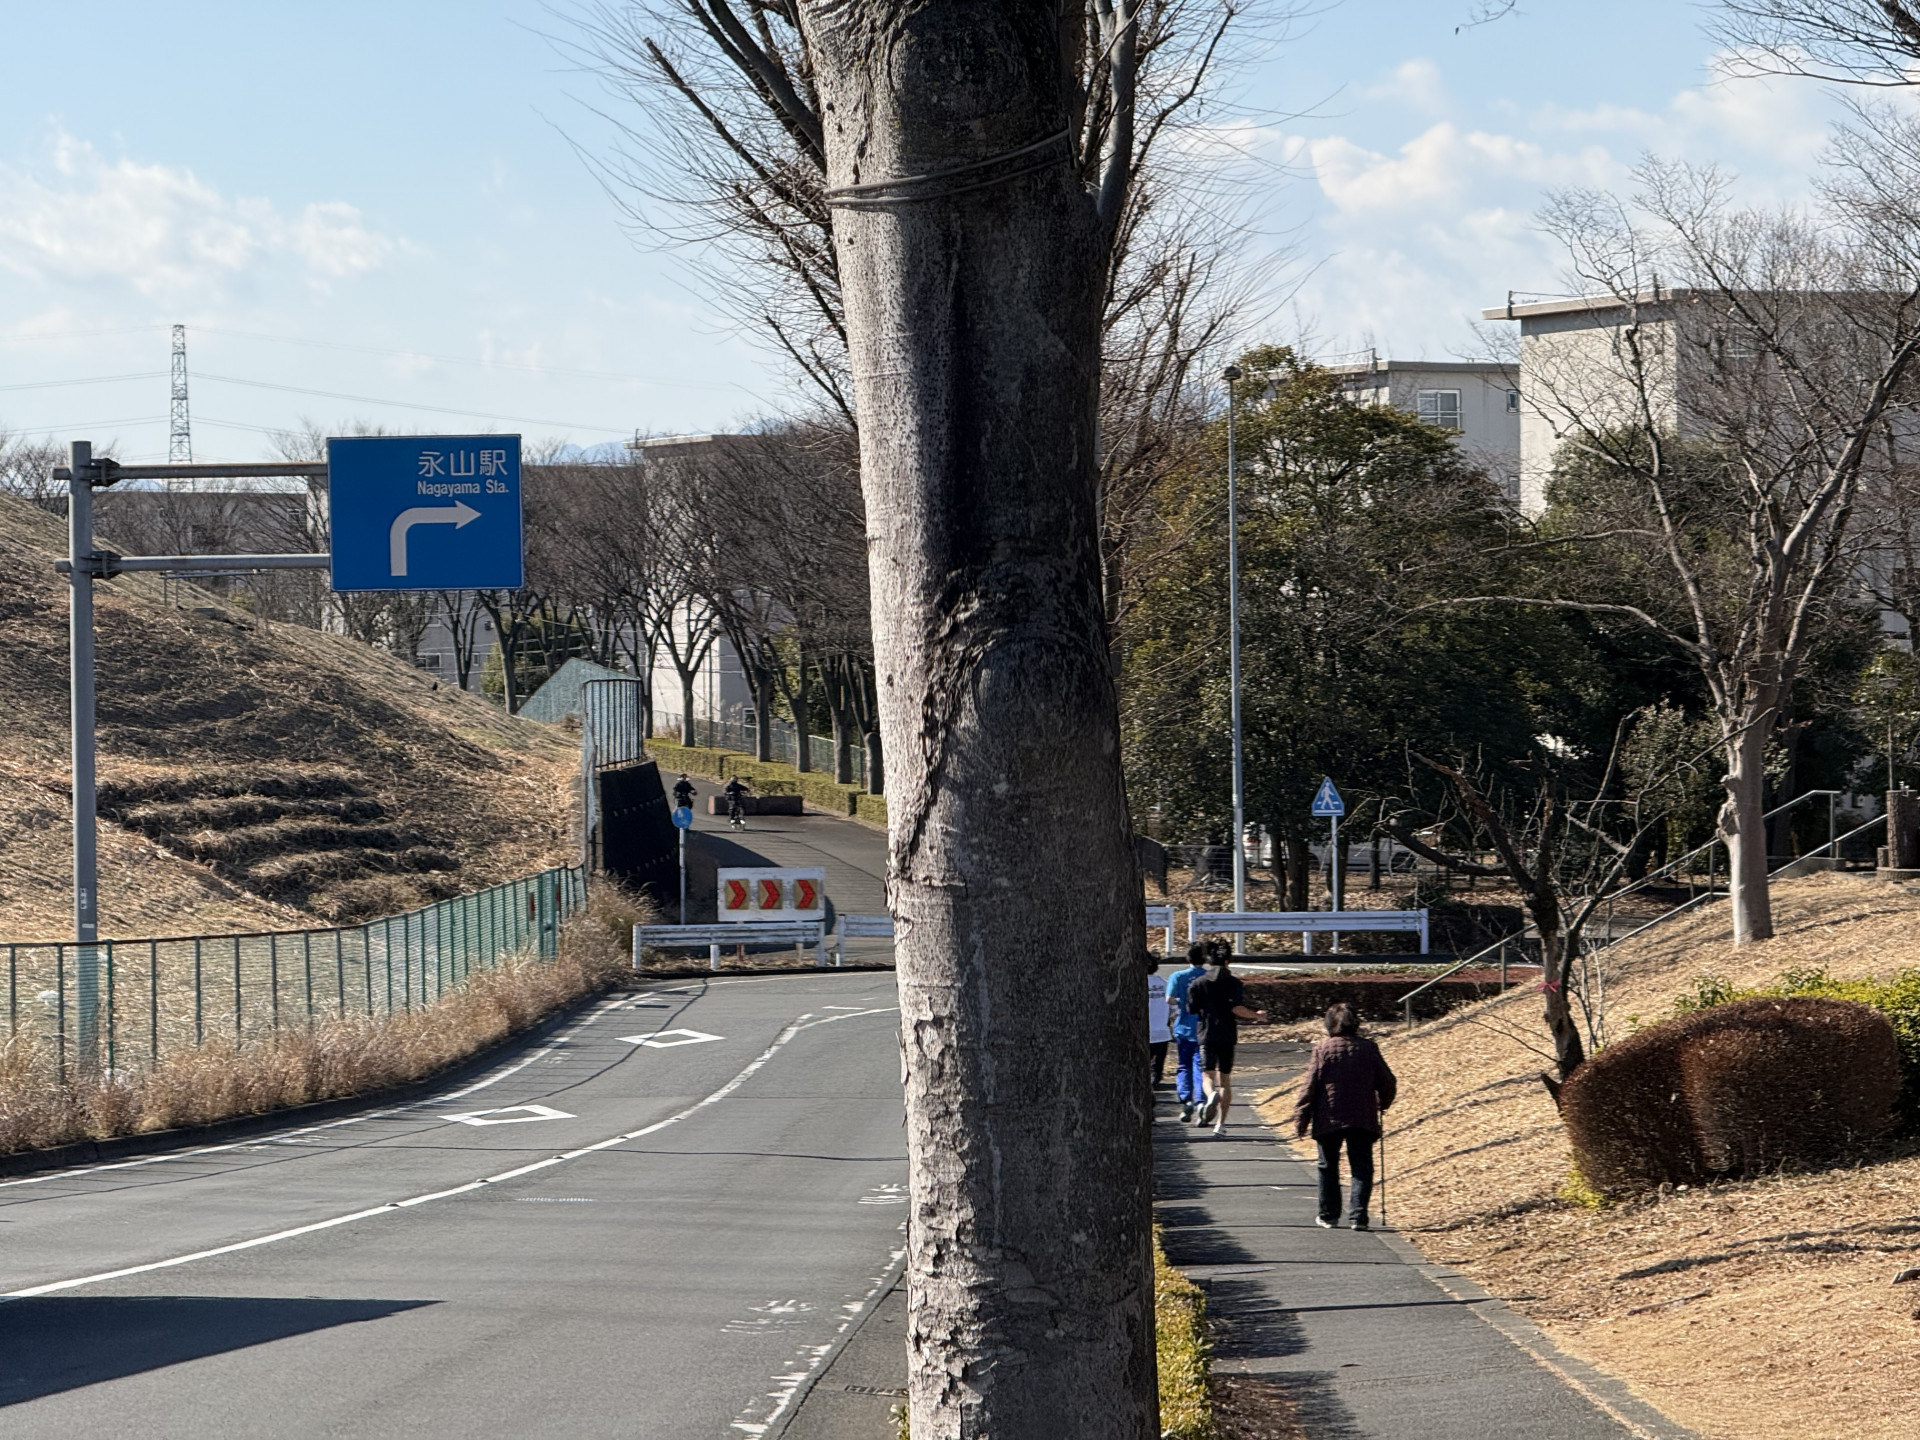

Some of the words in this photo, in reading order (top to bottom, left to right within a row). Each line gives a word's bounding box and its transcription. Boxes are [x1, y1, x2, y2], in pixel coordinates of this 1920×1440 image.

[417, 449, 508, 477] 永山駅
[417, 480, 480, 497] Nagayama
[485, 479, 509, 493] Sta.
